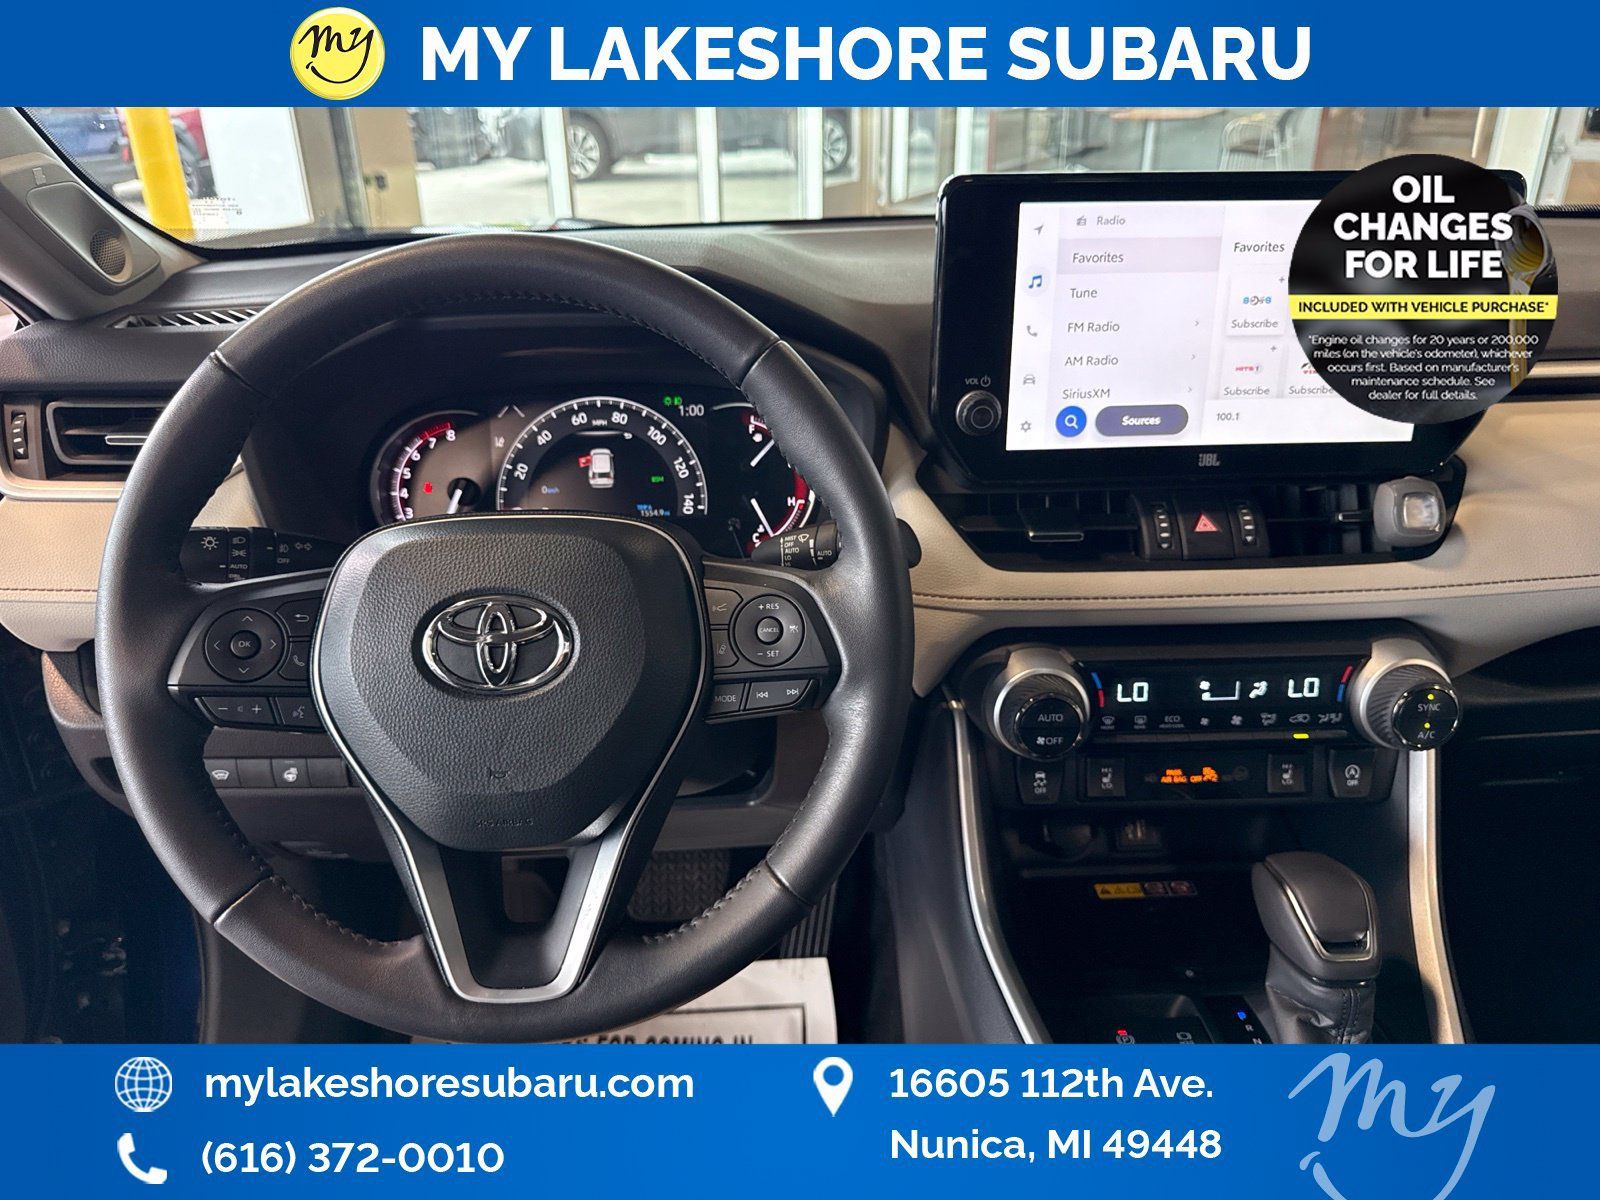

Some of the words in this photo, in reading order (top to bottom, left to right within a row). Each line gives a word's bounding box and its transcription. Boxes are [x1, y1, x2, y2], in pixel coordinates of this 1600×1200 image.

[1096, 215, 1126, 226] Radio
[1233, 241, 1285, 253] Favorites
[1072, 252, 1124, 264] Favorites
[1070, 287, 1098, 299] Tune
[1067, 322, 1084, 333] FM
[1088, 321, 1120, 333] Radio
[1231, 318, 1279, 329] Subscribe
[1064, 356, 1083, 367] AM
[1086, 355, 1119, 367] Radio
[1062, 388, 1110, 400] SiriusXM
[1223, 386, 1270, 396] Subscribe
[1289, 385, 1334, 395] Subscribe
[677, 404, 704, 417] 1:00
[1216, 412, 1240, 421] 100.1
[571, 413, 588, 426] 60
[611, 411, 629, 425] 80
[1121, 415, 1161, 426] Sources
[445, 429, 456, 441] 8
[536, 429, 552, 446] 40
[646, 426, 668, 446] 100
[428, 437, 437, 449] 7
[411, 450, 421, 461] 6
[402, 467, 411, 479] 5
[514, 463, 529, 480] 20
[673, 456, 690, 479] 120
[399, 487, 409, 499] 4
[682, 493, 695, 515] 140
[787, 496, 796, 507] H
[404, 507, 414, 519] 3
[1117, 681, 1149, 703] LO
[1288, 677, 1320, 698] LO
[715, 694, 737, 703] MODE
[1418, 703, 1441, 712] SYNC
[1037, 713, 1064, 722] AUTO
[1164, 715, 1180, 723] ECO
[1045, 736, 1063, 745] OFF
[1417, 730, 1435, 739] A/C
[1346, 778, 1359, 786] OFF
[1034, 786, 1047, 794] OFF
